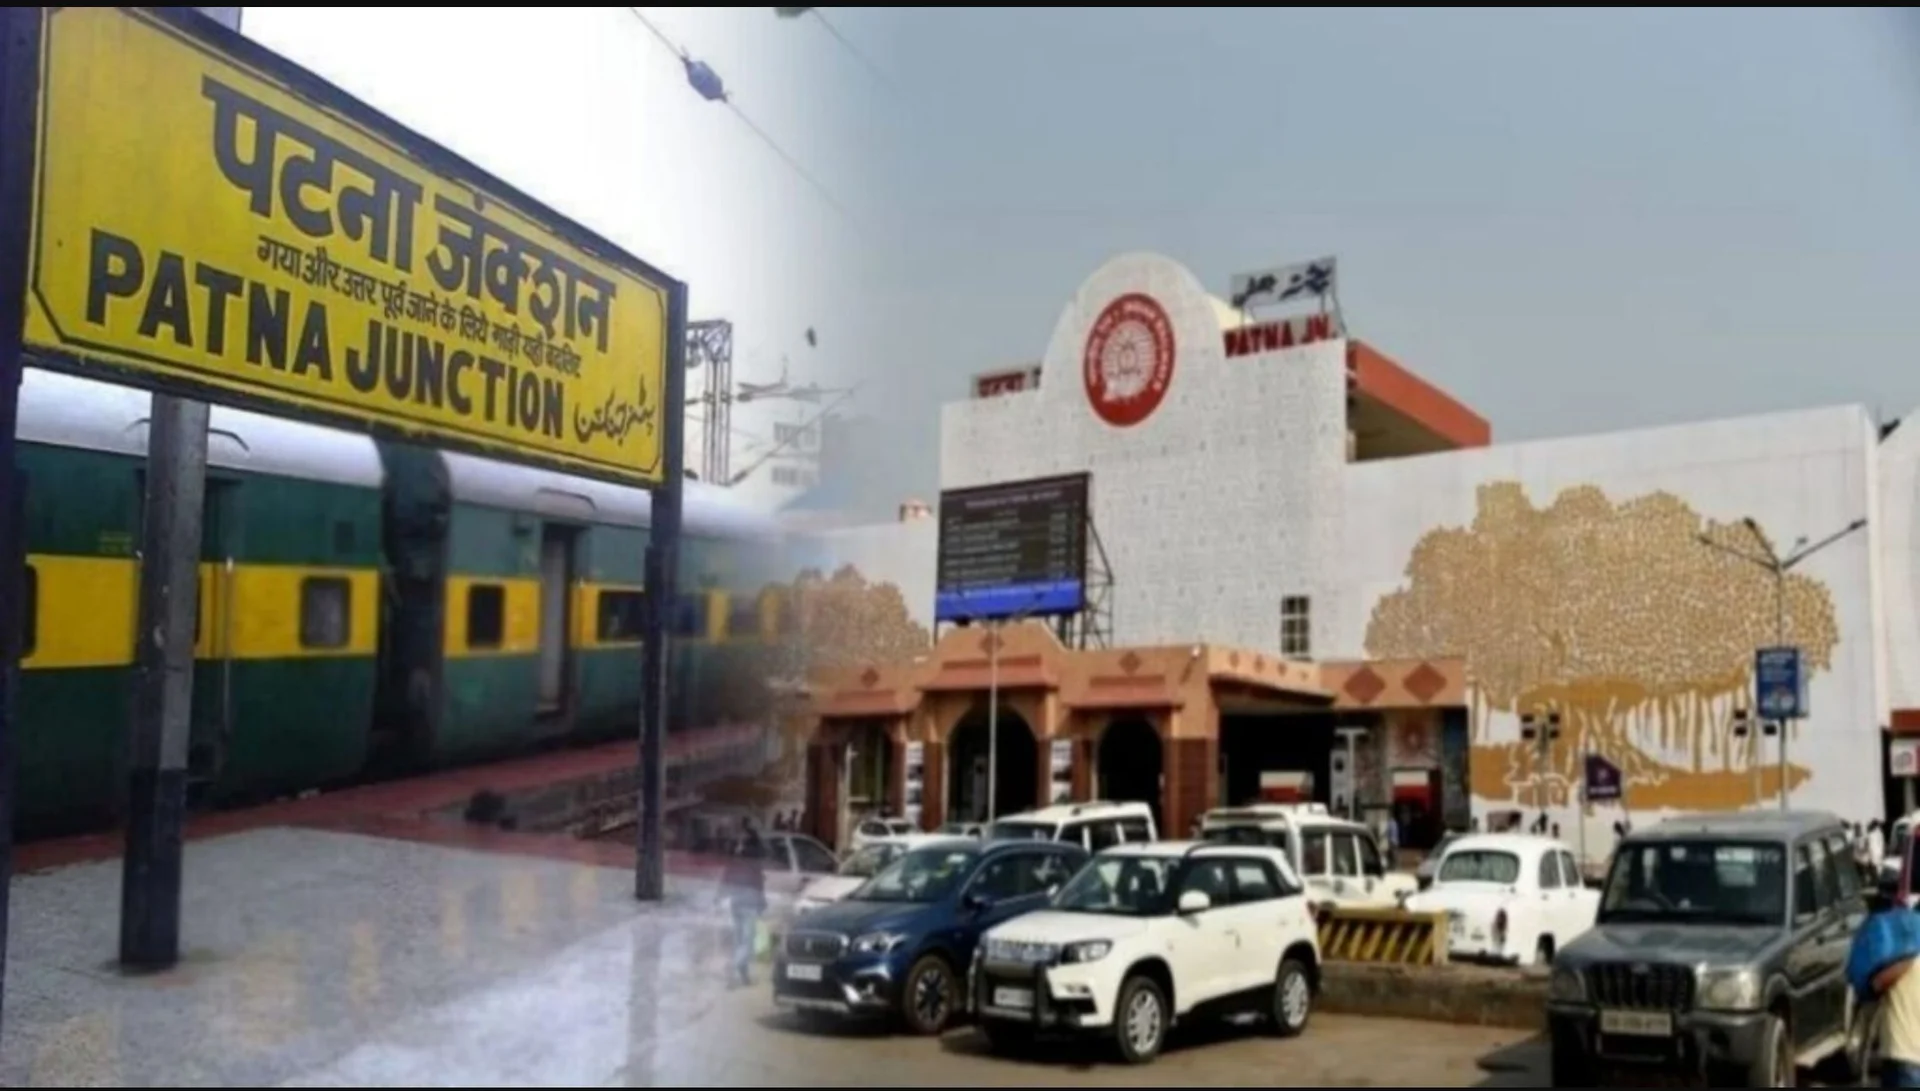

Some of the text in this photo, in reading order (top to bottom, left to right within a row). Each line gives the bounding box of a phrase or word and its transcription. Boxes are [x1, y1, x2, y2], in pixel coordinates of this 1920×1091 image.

[202, 75, 616, 353] पटना जंक्शन
[257, 235, 302, 279] गया
[302, 247, 341, 291] और
[342, 268, 377, 305] उत्तर
[380, 280, 407, 319] पूर्व
[405, 292, 438, 327] जाने
[439, 298, 456, 330] के
[86, 227, 563, 439] PATNA JUNCTION
[1224, 320, 1294, 358] PATNA
